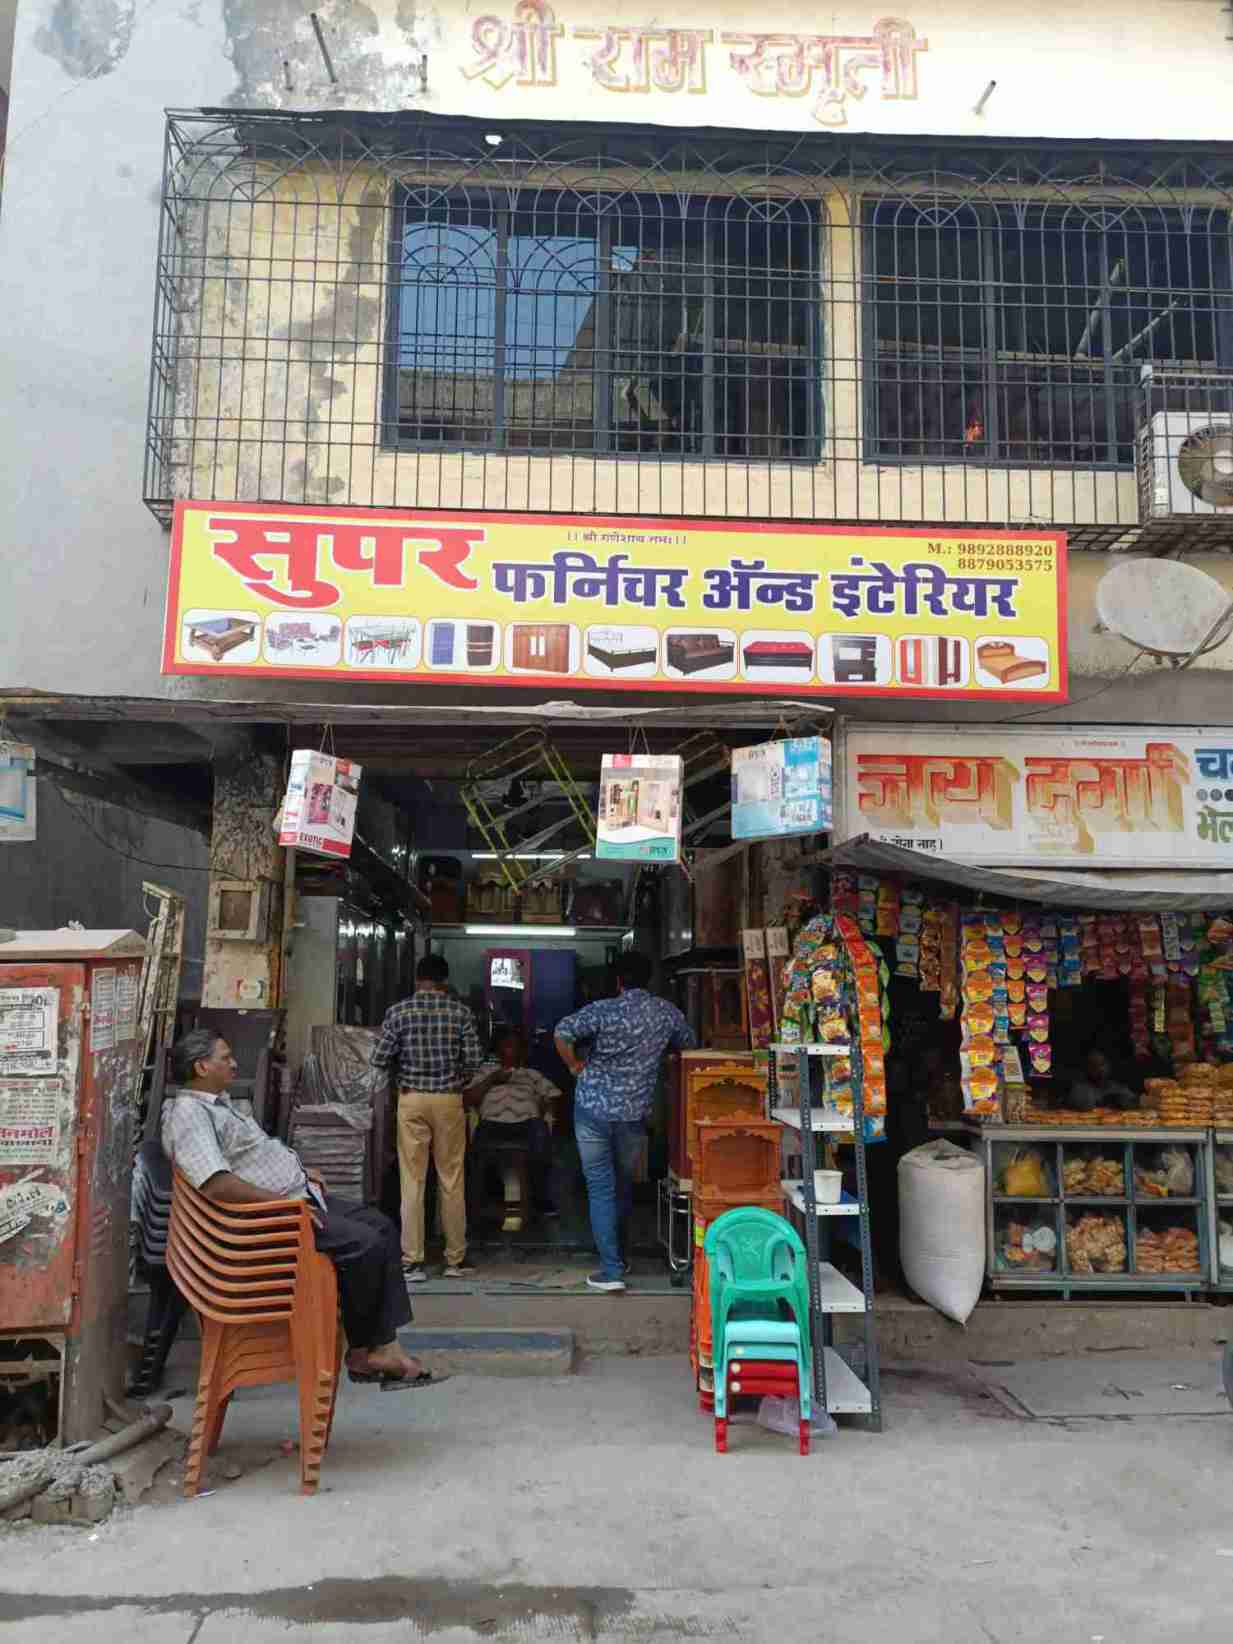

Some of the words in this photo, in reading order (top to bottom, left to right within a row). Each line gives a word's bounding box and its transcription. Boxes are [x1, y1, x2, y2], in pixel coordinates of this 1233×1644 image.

[572, 26, 713, 94] राम
[209, 519, 485, 609] सुपर
[958, 543, 1053, 556] 9892888920
[958, 559, 1053, 571] 8879053575
[492, 552, 688, 608] फर्निचर
[831, 557, 1018, 618] इंटेरियर
[857, 754, 1019, 831] जय
